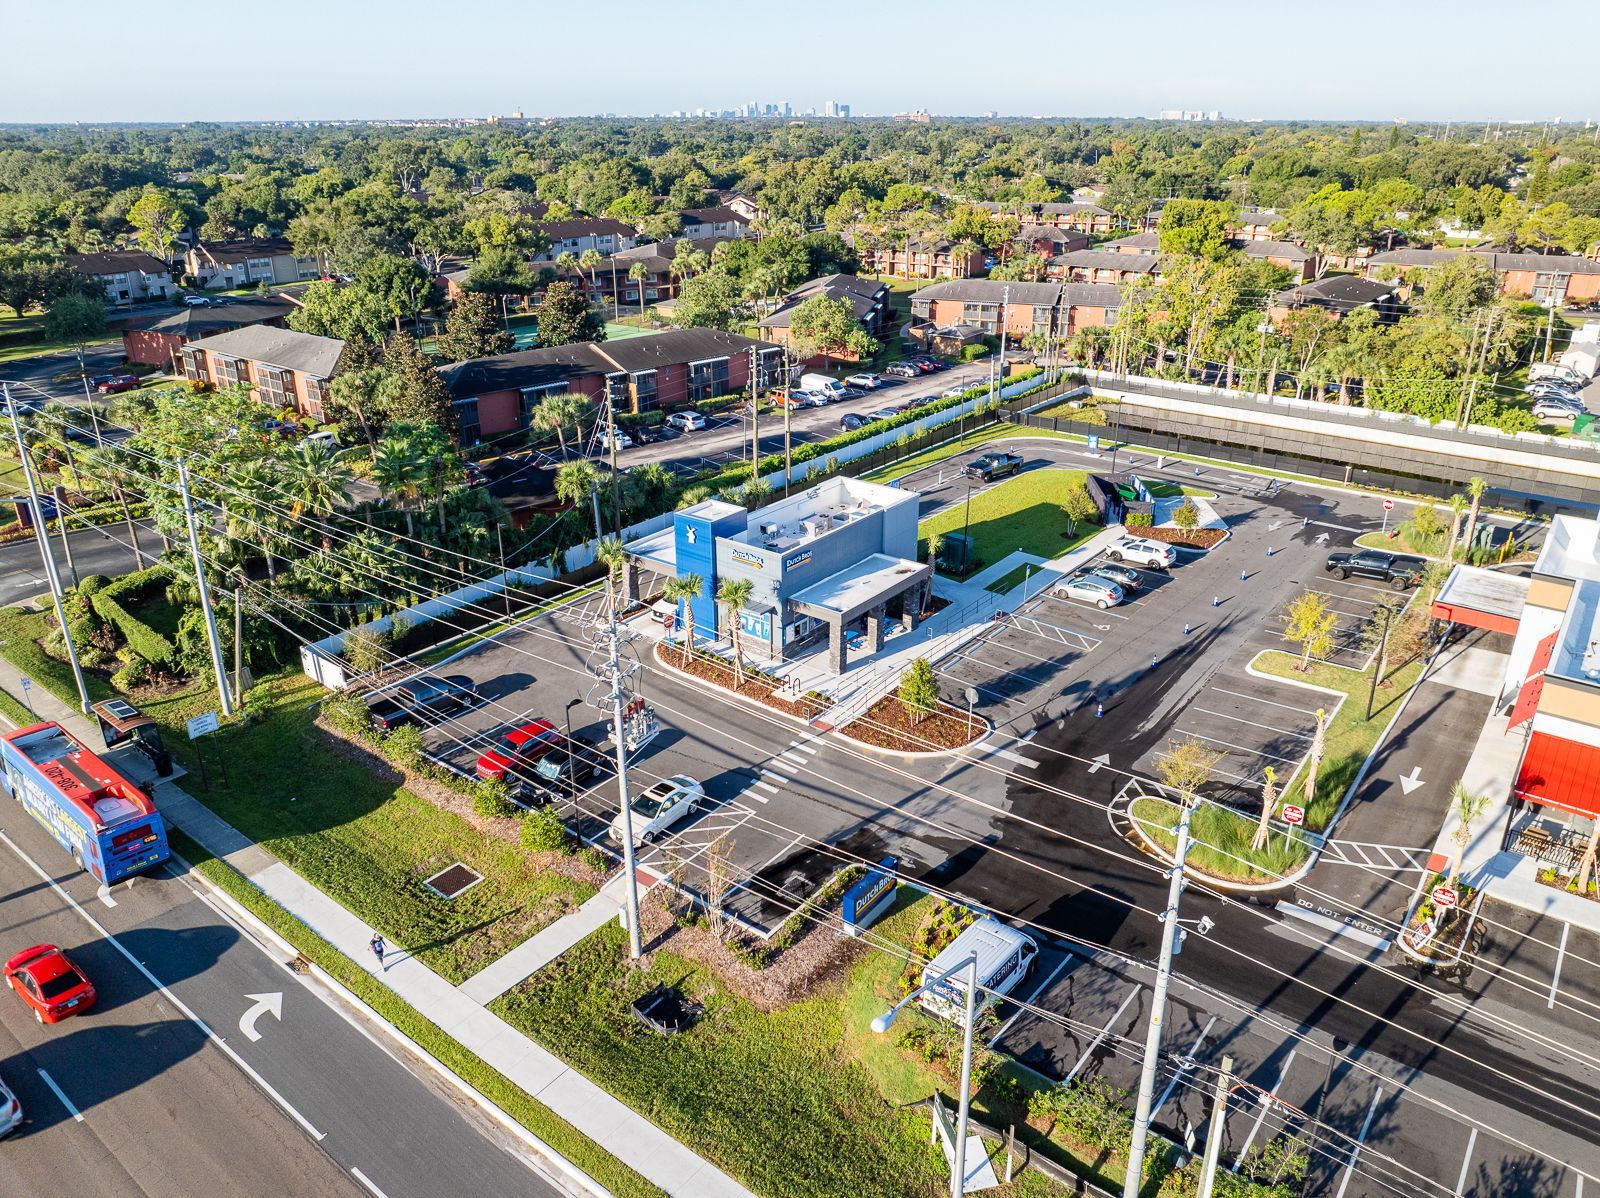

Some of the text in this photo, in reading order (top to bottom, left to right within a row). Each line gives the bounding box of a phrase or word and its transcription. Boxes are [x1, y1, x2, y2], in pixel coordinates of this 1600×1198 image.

[856, 884, 879, 911] DUTCH
[1297, 898, 1383, 936] DO NOT ENTER
